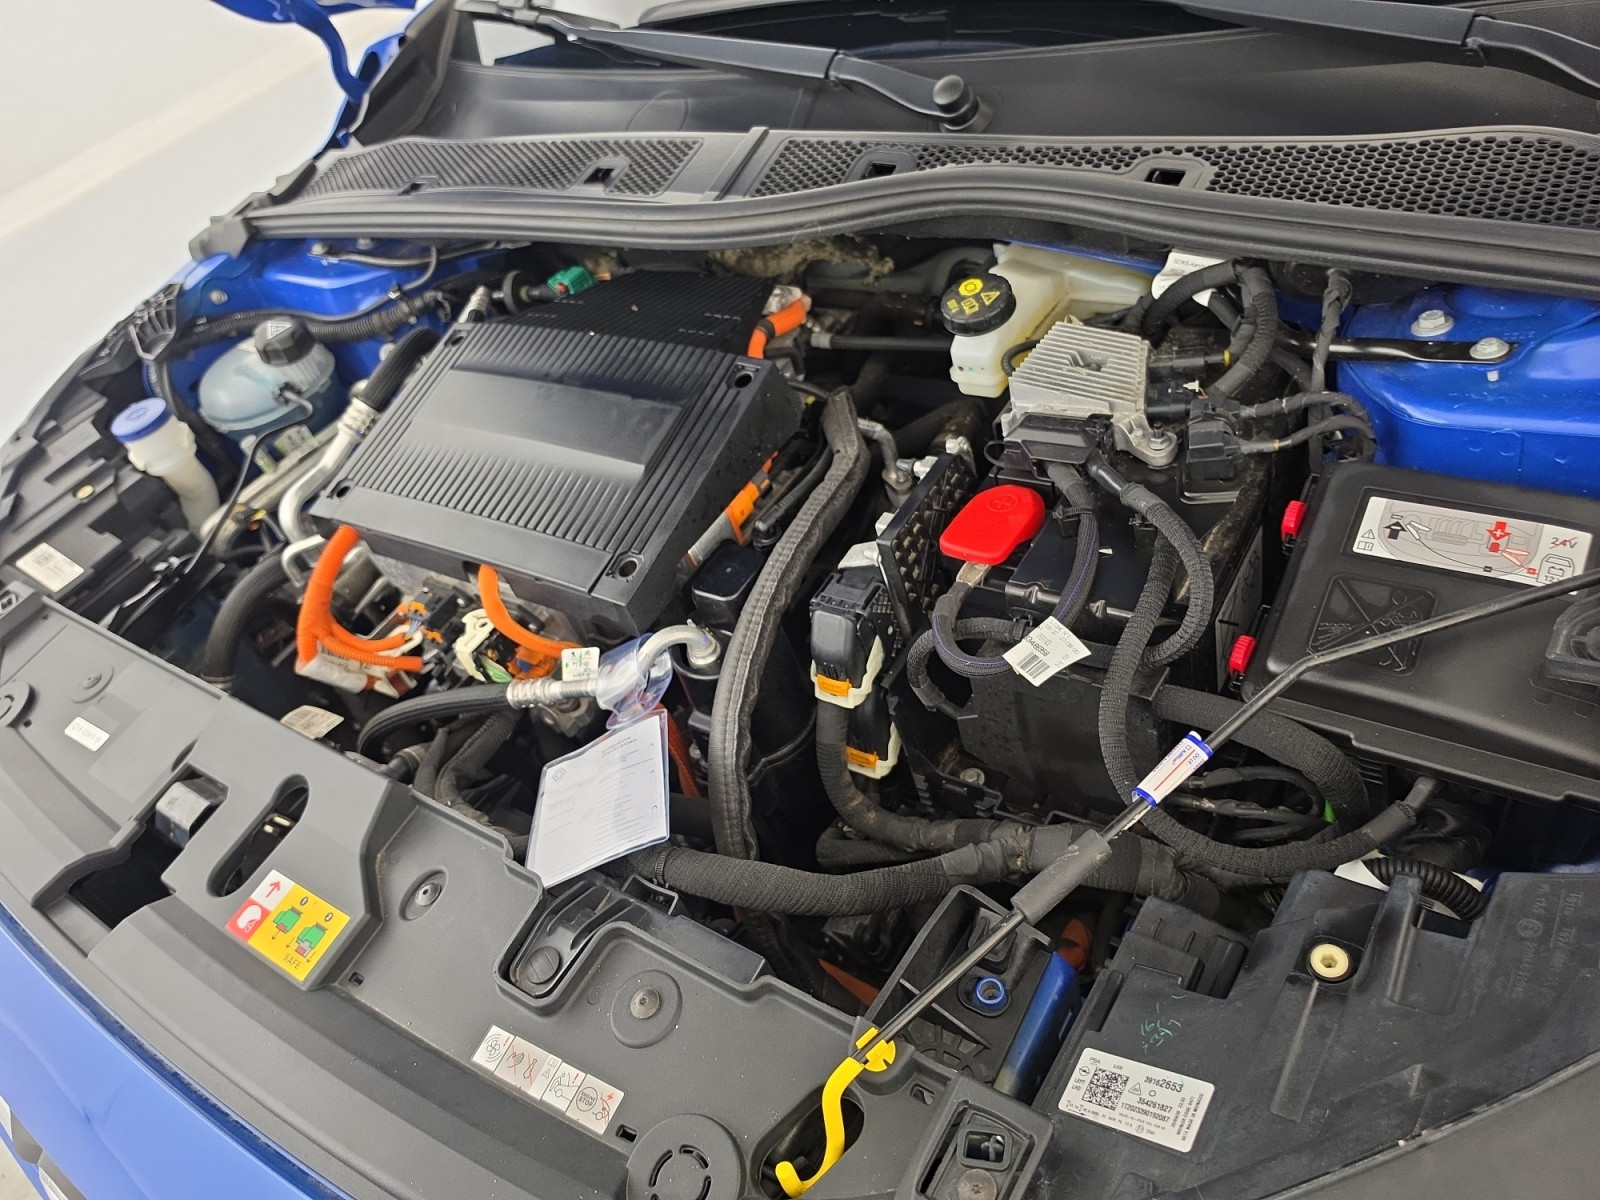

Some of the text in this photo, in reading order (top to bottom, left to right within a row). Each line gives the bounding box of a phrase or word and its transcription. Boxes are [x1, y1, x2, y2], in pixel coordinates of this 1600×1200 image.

[283, 953, 302, 970] SAFE
[1143, 1076, 1184, 1093] 39162653
[579, 1096, 594, 1107] STOP
[581, 1091, 597, 1102] ENGINE
[1136, 1096, 1173, 1113] 354261827
